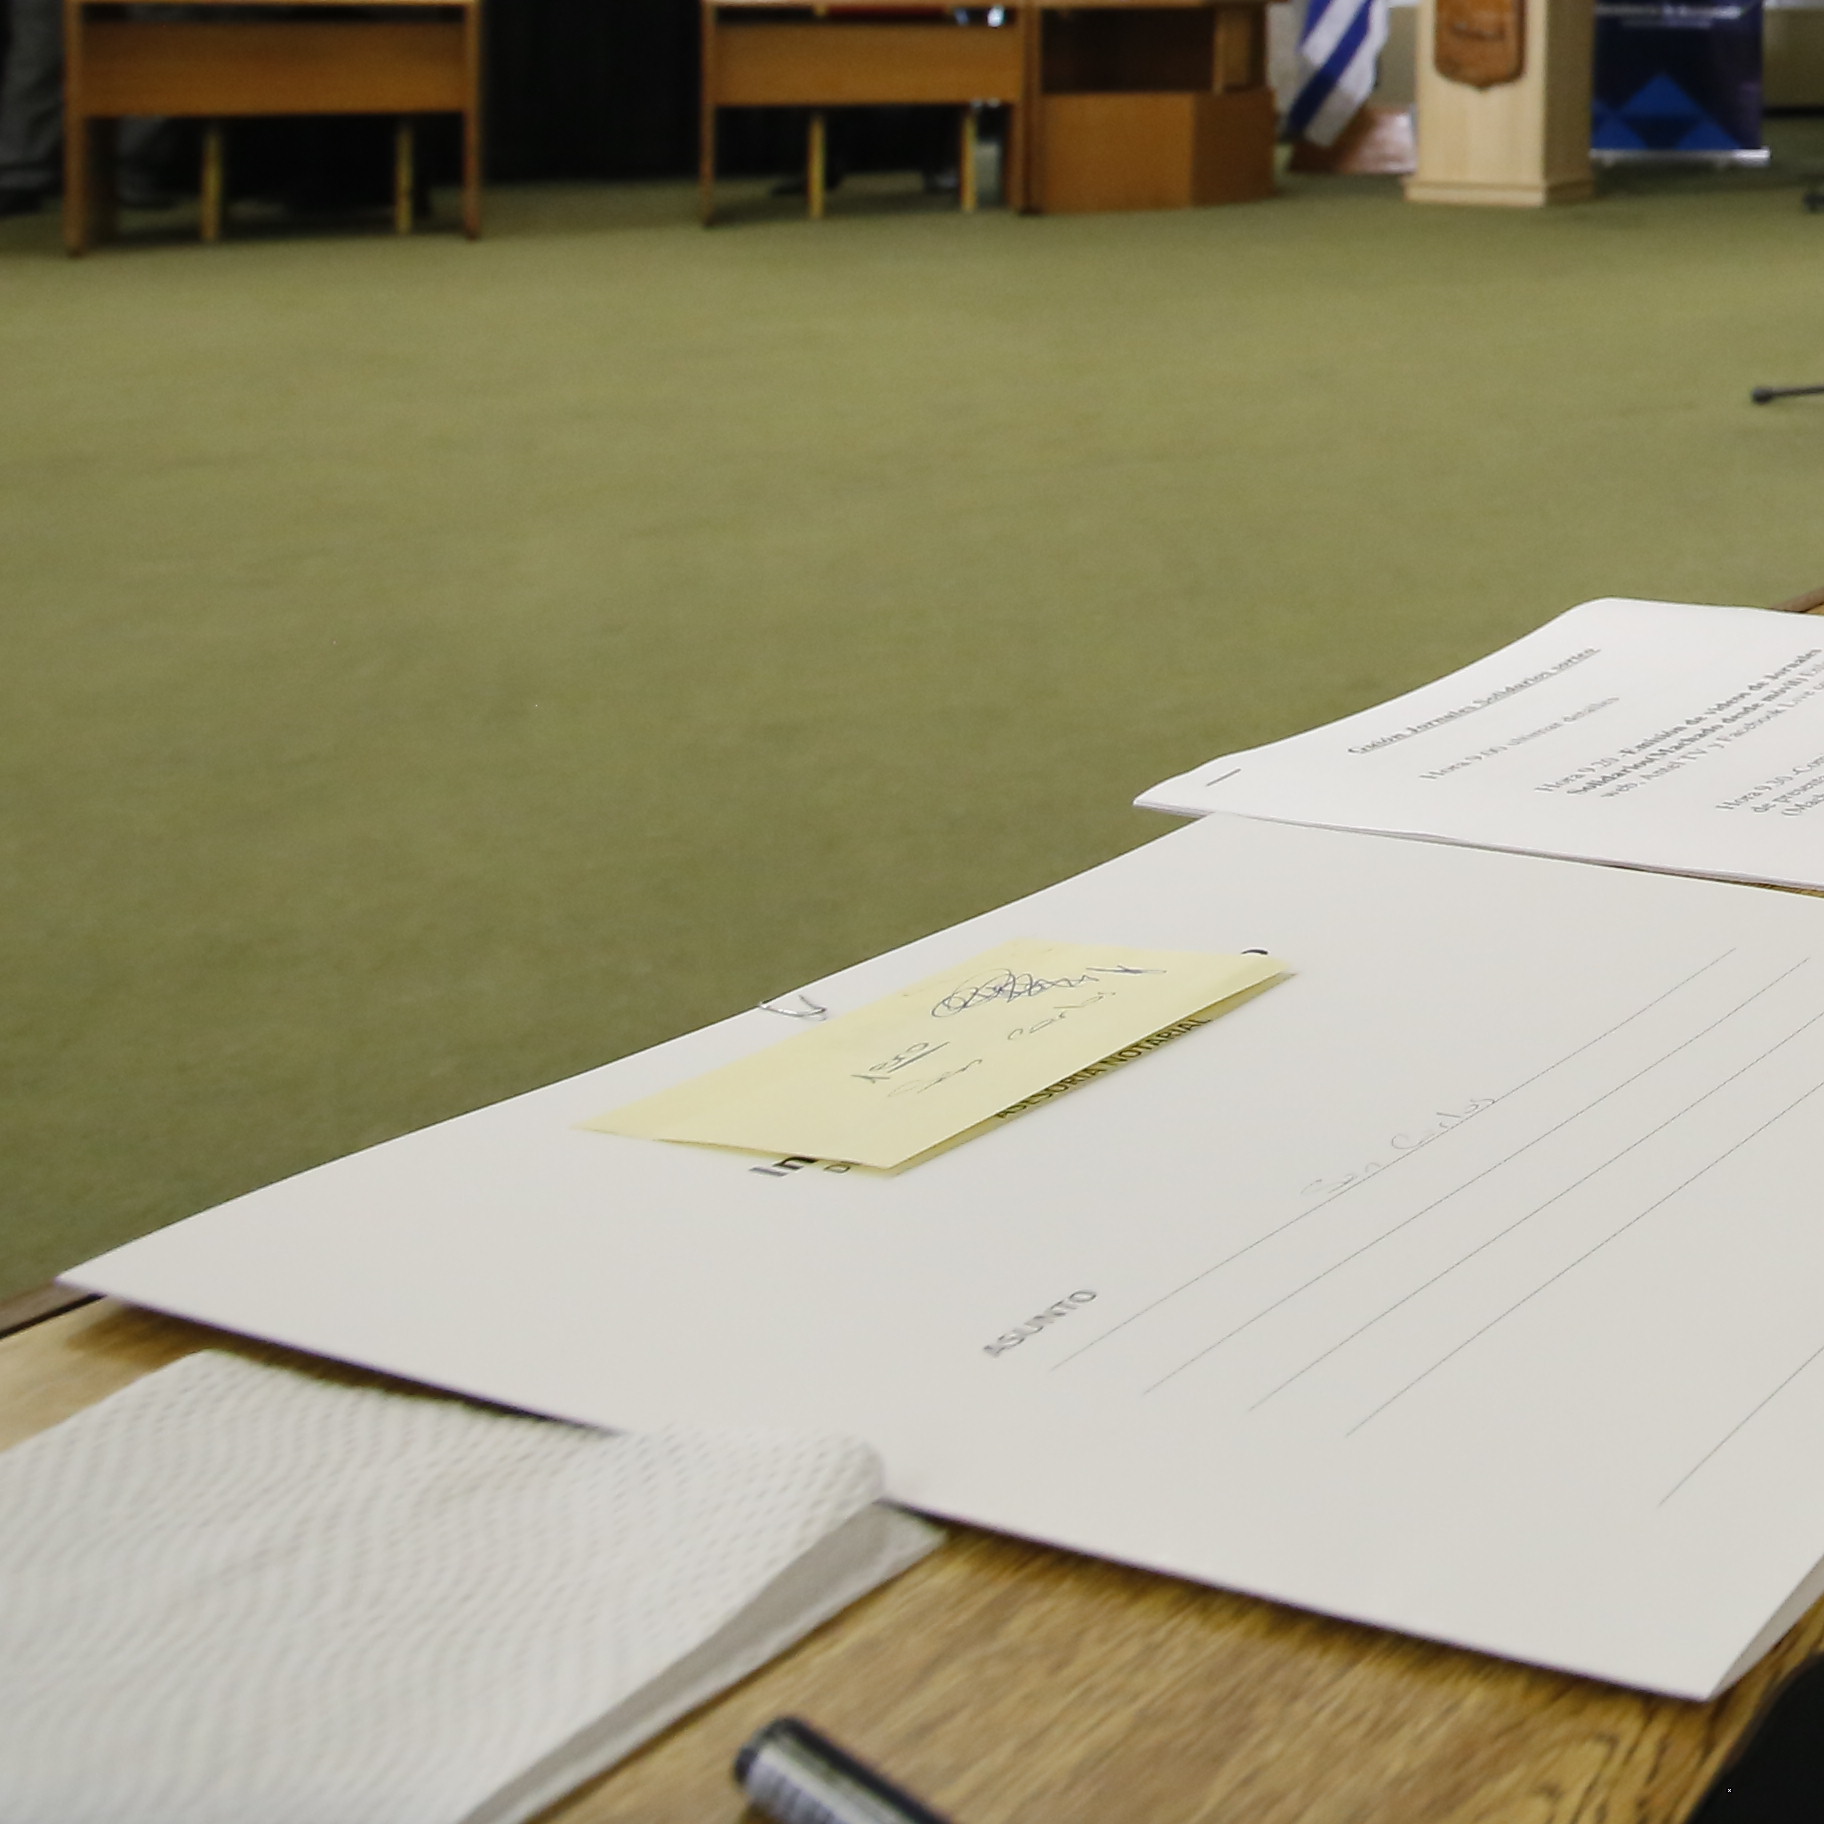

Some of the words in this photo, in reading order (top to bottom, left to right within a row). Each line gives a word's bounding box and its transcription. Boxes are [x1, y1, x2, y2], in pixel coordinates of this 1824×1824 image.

[1534, 772, 1585, 793] Hora
[1765, 648, 1823, 682] Jornales
[1716, 707, 1787, 743] Facebook
[1722, 702, 1764, 725] desde
[1715, 791, 1763, 811] Hora
[1099, 1018, 1213, 1066] NOTARIAL
[983, 1290, 1097, 1357] ASUNTO
